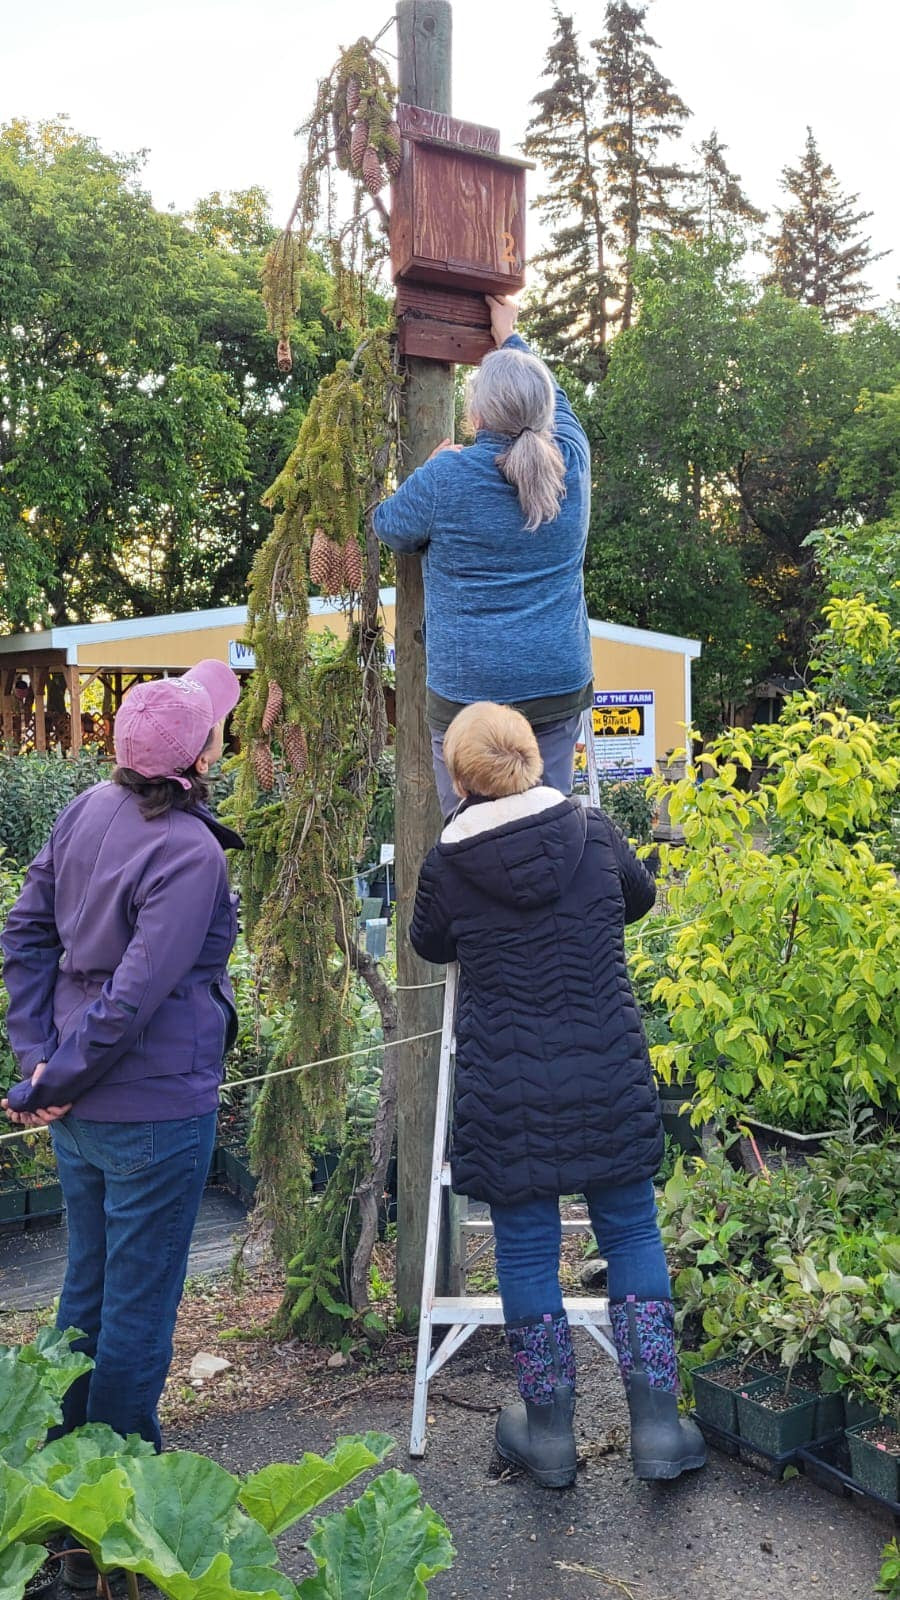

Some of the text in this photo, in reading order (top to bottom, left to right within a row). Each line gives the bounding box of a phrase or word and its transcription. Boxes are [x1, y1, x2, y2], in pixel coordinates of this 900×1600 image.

[500, 231, 516, 262] 2
[596, 694, 651, 703] OF THE FARM
